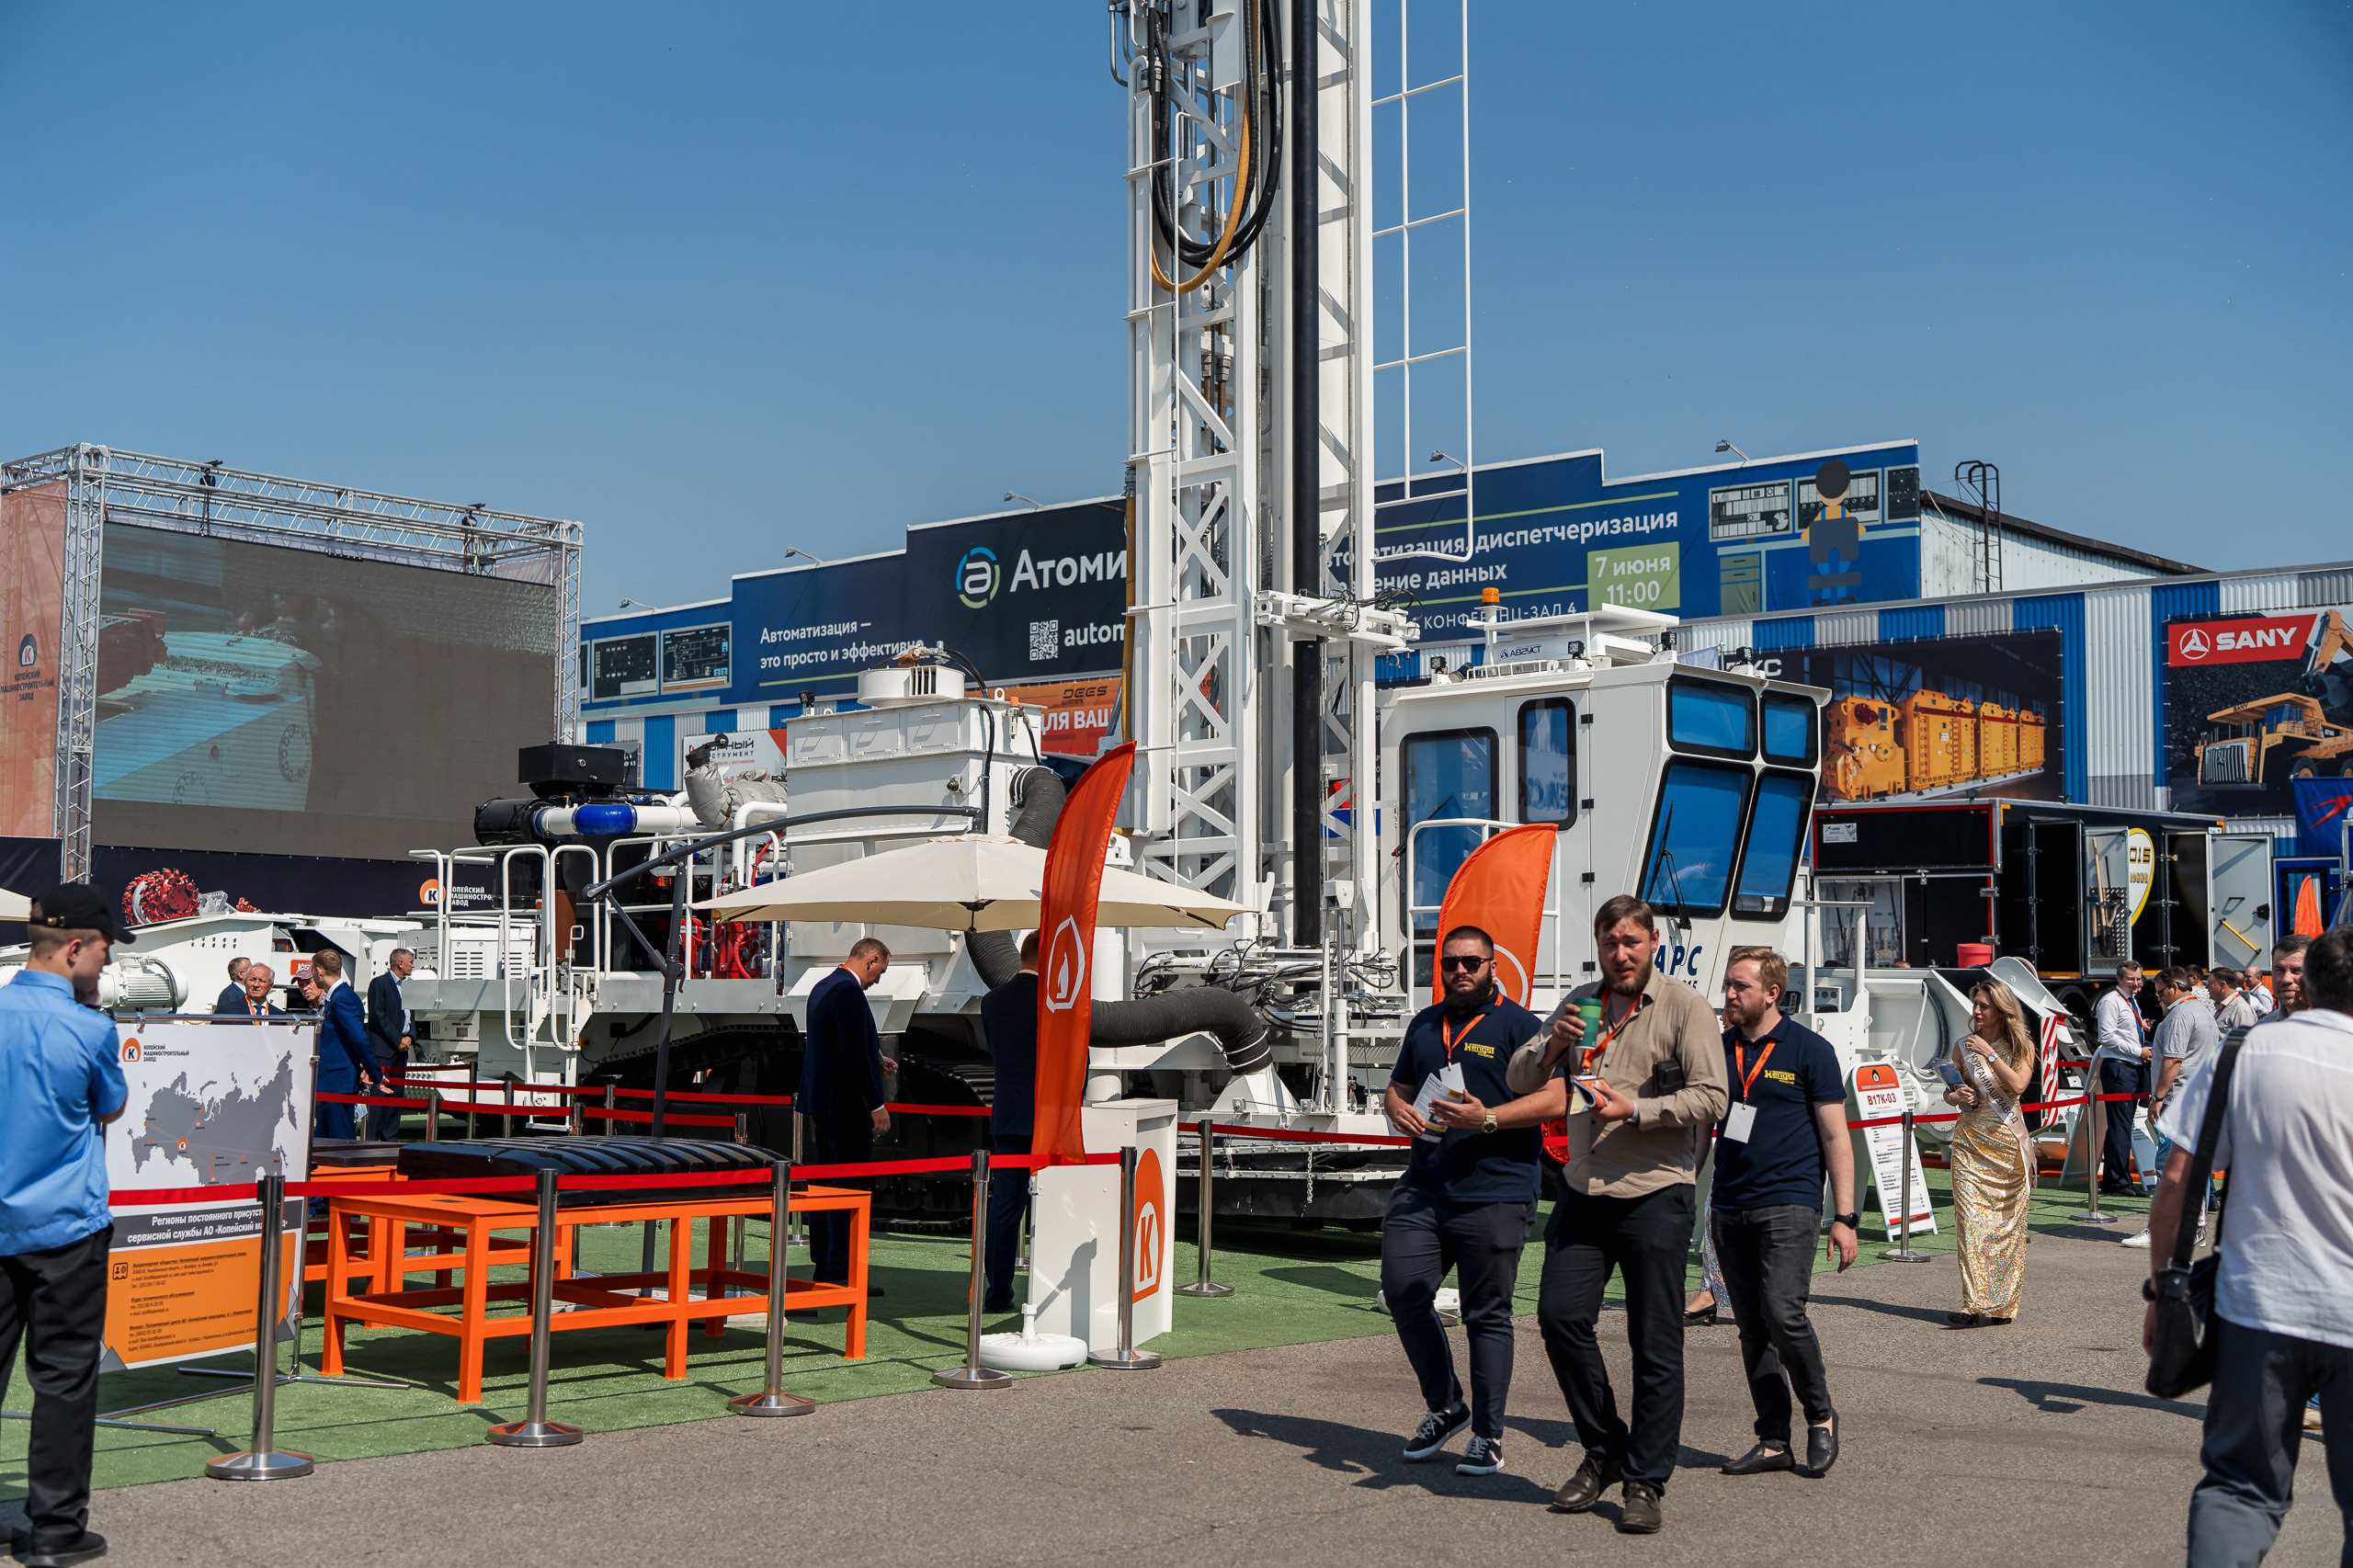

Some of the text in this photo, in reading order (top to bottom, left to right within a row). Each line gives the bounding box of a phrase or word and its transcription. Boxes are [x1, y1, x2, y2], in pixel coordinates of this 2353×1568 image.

[1474, 511, 1678, 553] диспетчеризация
[1009, 549, 1127, 593] Атоми
[1426, 563, 1507, 590] данных
[1595, 556, 1671, 578] 7 июня
[1606, 580, 1661, 606] 11:00
[1425, 604, 1562, 631] КОНФЕРНЦ-ЗАЛ
[760, 620, 858, 644] Автоматизация
[1063, 622, 1126, 647] autom
[2215, 626, 2298, 652] SANY
[760, 655, 781, 669] это
[783, 650, 828, 670] просто
[831, 649, 839, 661] и
[1063, 686, 1108, 699] DEES
[1074, 708, 1111, 730] ВАШ
[711, 751, 755, 759] СТРУМЕНТ
[450, 899, 469, 907] АВОД
[1654, 945, 1703, 977] АРС
[1463, 1042, 1495, 1055] Hengst
[1764, 1069, 1795, 1081] Hengst
[1970, 1053, 2019, 1125] КУРГАНМАШЗАВОД
[152, 1208, 264, 1227] Регионы постоянного присутст
[127, 1229, 172, 1244] сервисной
[173, 1226, 202, 1241] службы
[203, 1225, 213, 1236] АО
